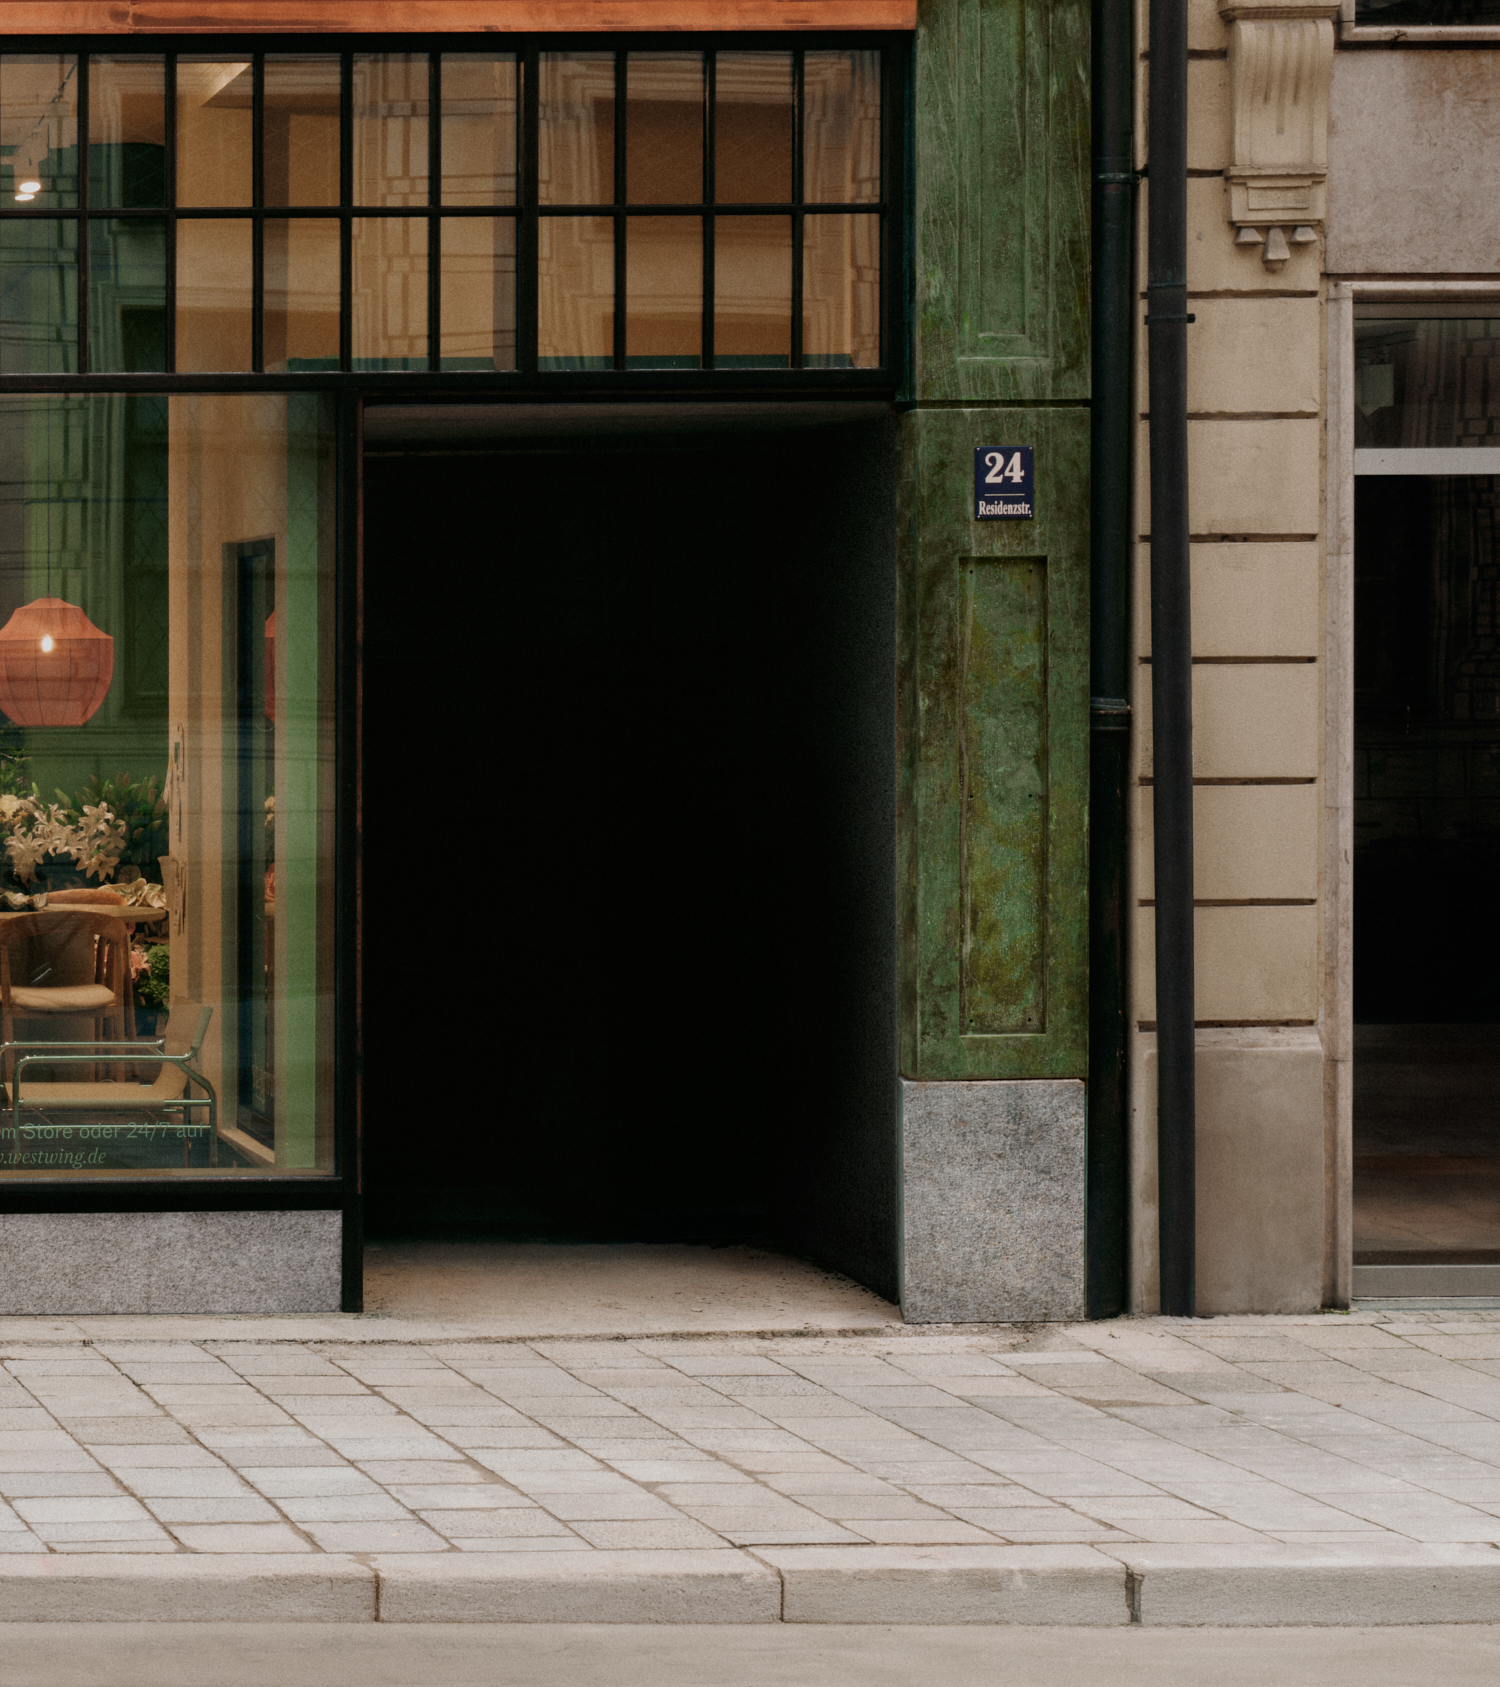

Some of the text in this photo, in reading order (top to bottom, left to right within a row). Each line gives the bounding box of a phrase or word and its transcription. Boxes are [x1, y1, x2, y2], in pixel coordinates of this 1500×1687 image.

[985, 451, 1025, 484] 24
[978, 500, 1032, 515] Residenzstr.
[22, 1122, 73, 1139] Store
[79, 1122, 121, 1139] oder
[126, 1121, 171, 1142] 24/7
[176, 1121, 205, 1138] auf
